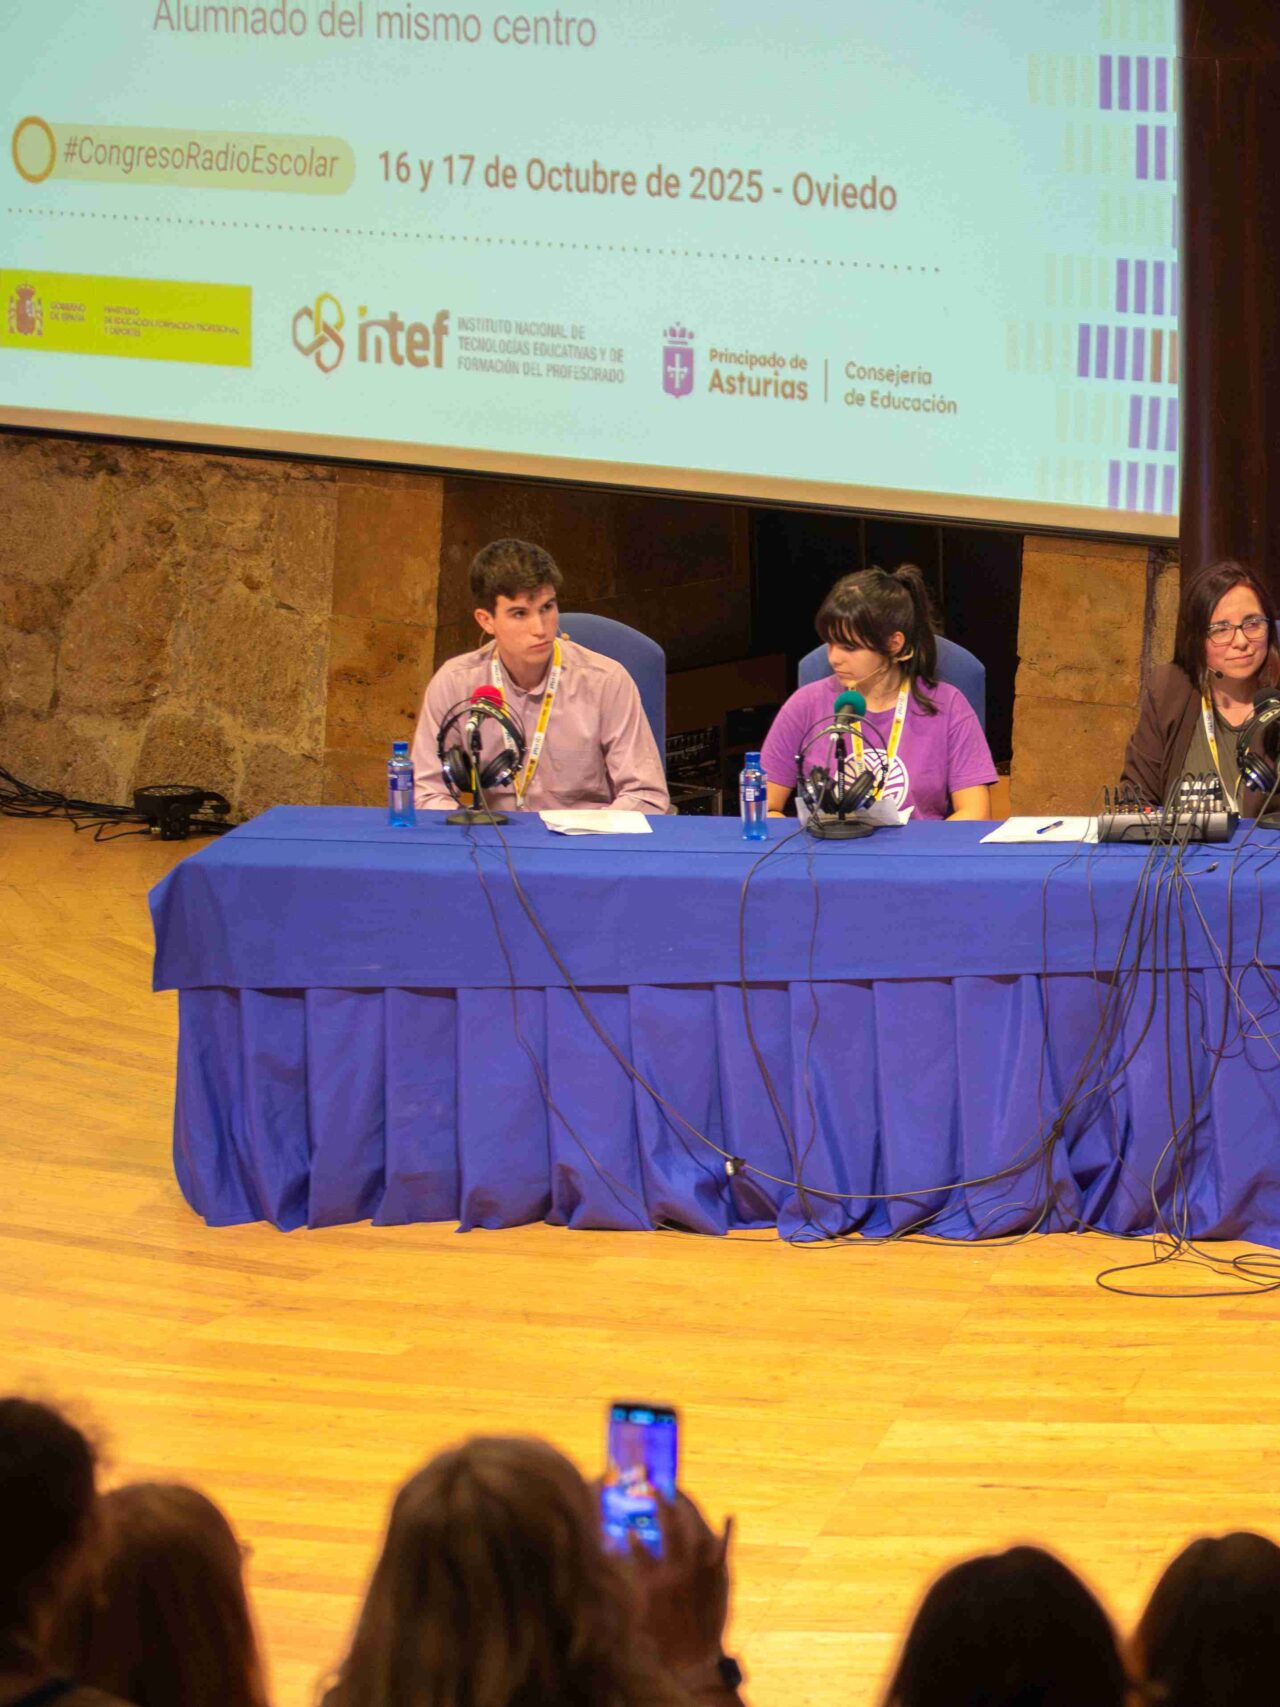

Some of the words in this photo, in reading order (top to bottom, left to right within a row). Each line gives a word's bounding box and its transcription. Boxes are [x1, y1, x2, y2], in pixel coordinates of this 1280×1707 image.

[153, 0, 307, 37] Alumnado
[318, 0, 363, 39] del
[376, 2, 482, 44] mismo
[493, 10, 597, 48] centro
[64, 137, 340, 178] #CongresoRadioEscolar
[379, 151, 411, 184] 16
[418, 159, 433, 191] y
[443, 154, 475, 186] 17
[484, 155, 518, 189] de
[526, 158, 638, 196] Octubre
[646, 164, 680, 198] de
[689, 166, 764, 202] 2025
[792, 172, 898, 211] Oviedo
[358, 305, 450, 368] intef
[458, 317, 512, 335] INSTITUTO
[515, 321, 567, 338] NACIONAL
[571, 325, 585, 339] DE
[458, 335, 530, 355] TECNOLOGÍAS
[533, 342, 597, 362] EDUCATIVAS
[610, 348, 624, 363] DE
[709, 348, 785, 370] Principado
[789, 354, 807, 371] de
[457, 356, 519, 375] FORMACIÓN
[523, 361, 543, 377] DEL
[546, 364, 625, 383] PROFESORADO
[708, 367, 808, 401] Asturias
[844, 388, 865, 407] de
[870, 390, 958, 414] Educación
